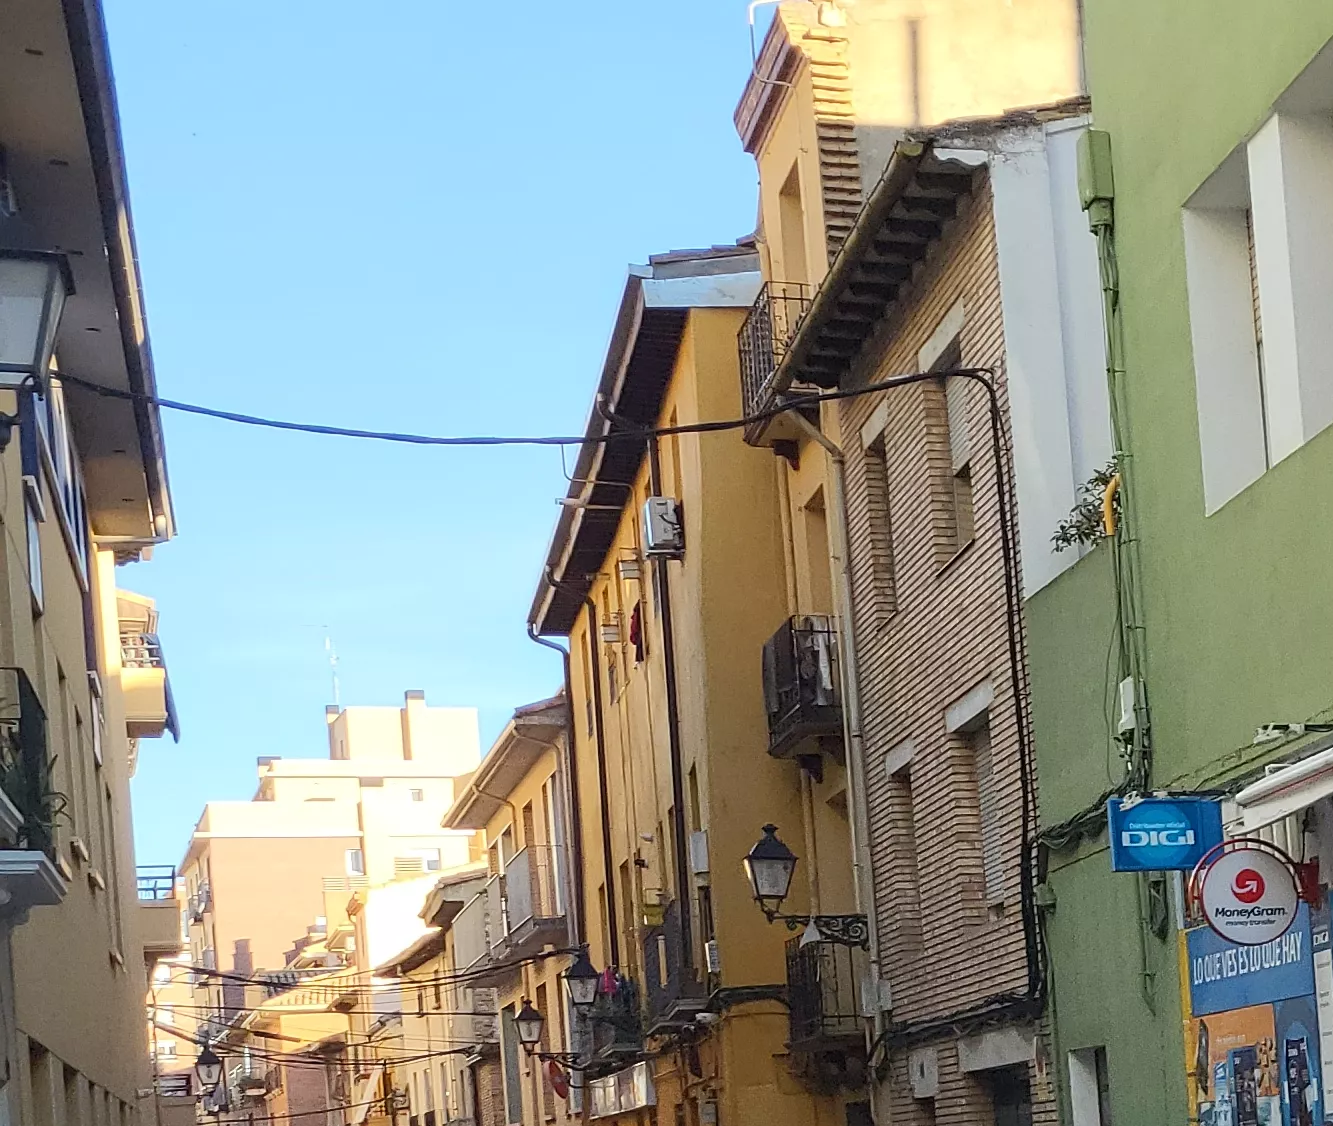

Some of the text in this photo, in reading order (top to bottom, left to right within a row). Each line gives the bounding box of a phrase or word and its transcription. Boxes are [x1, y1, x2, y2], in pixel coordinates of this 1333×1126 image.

[1122, 829, 1195, 847] DIGI
[1215, 905, 1286, 919] MoneyGram
[1193, 931, 1303, 985] LO QUE VES ES LO QUE HAY
